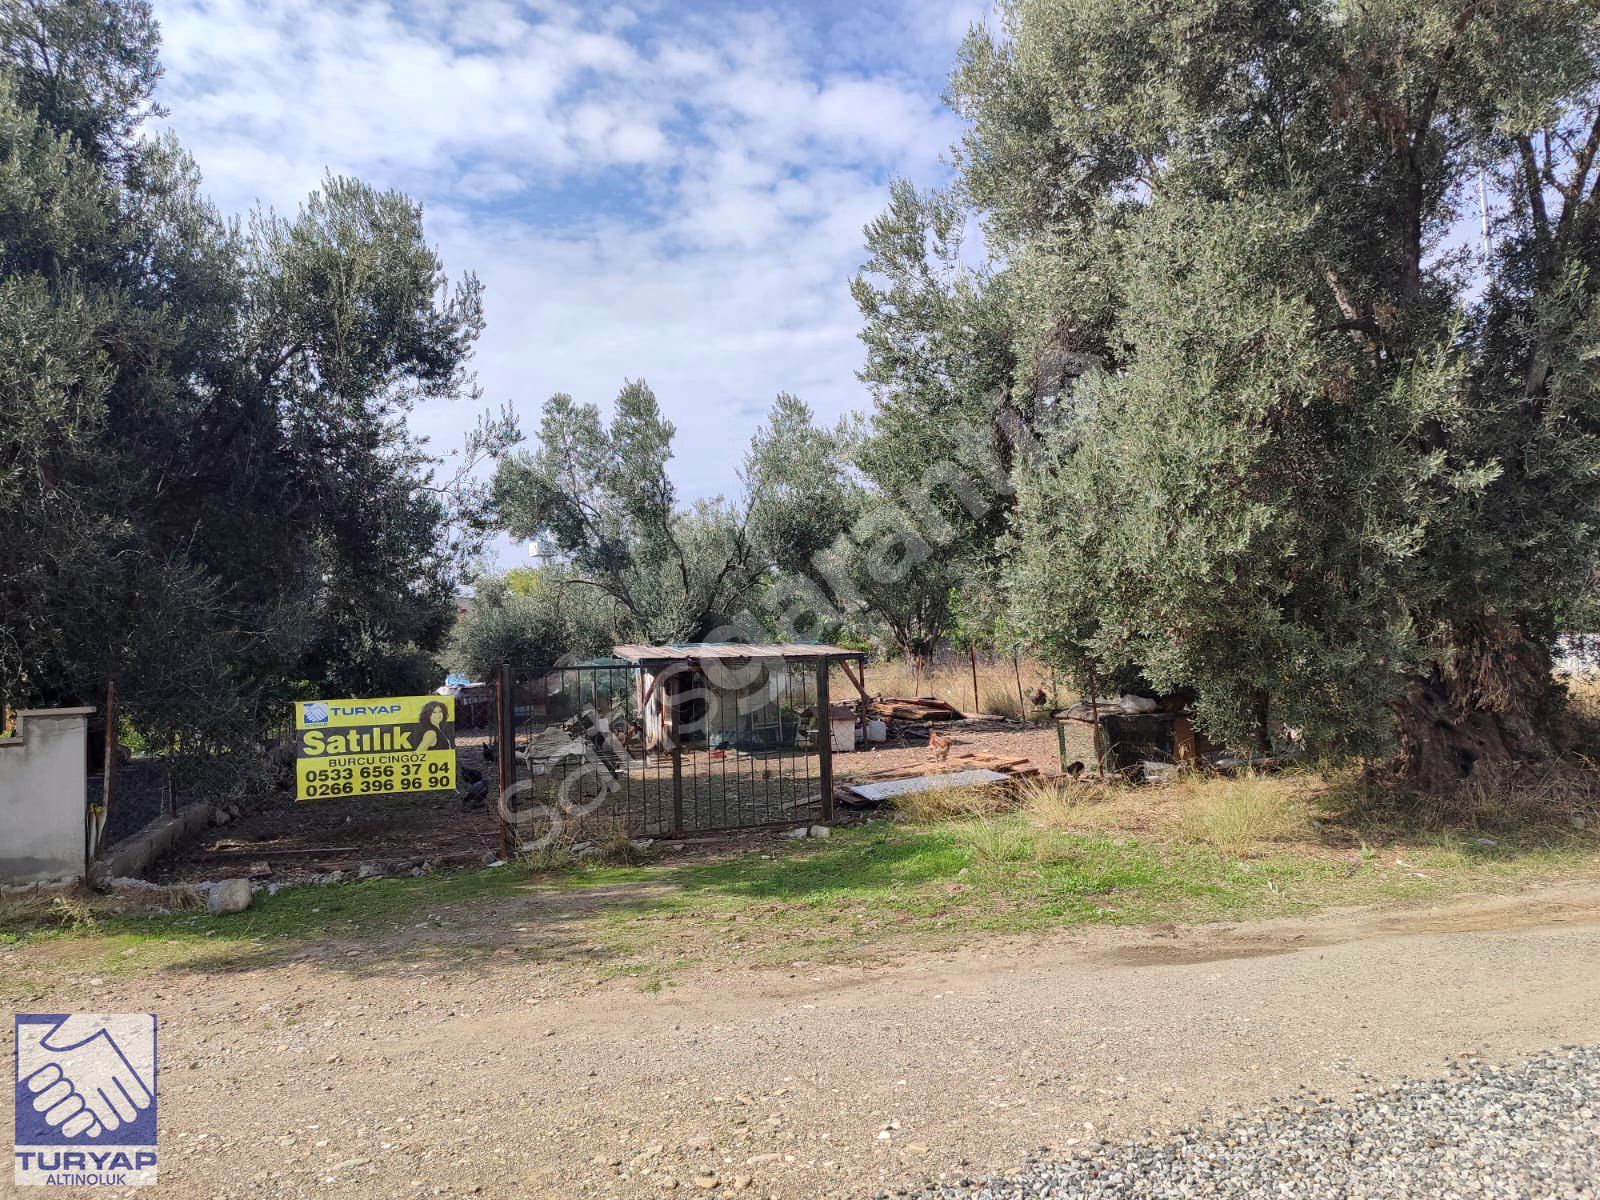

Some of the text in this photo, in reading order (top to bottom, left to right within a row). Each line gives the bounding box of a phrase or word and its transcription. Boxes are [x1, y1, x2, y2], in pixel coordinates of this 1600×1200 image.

[330, 705, 402, 716] TURYAP
[303, 727, 413, 755] Satılık
[305, 761, 450, 783] 0533 656 37 04
[328, 756, 375, 768] BURCU
[305, 775, 450, 797] 0266 396 96 90
